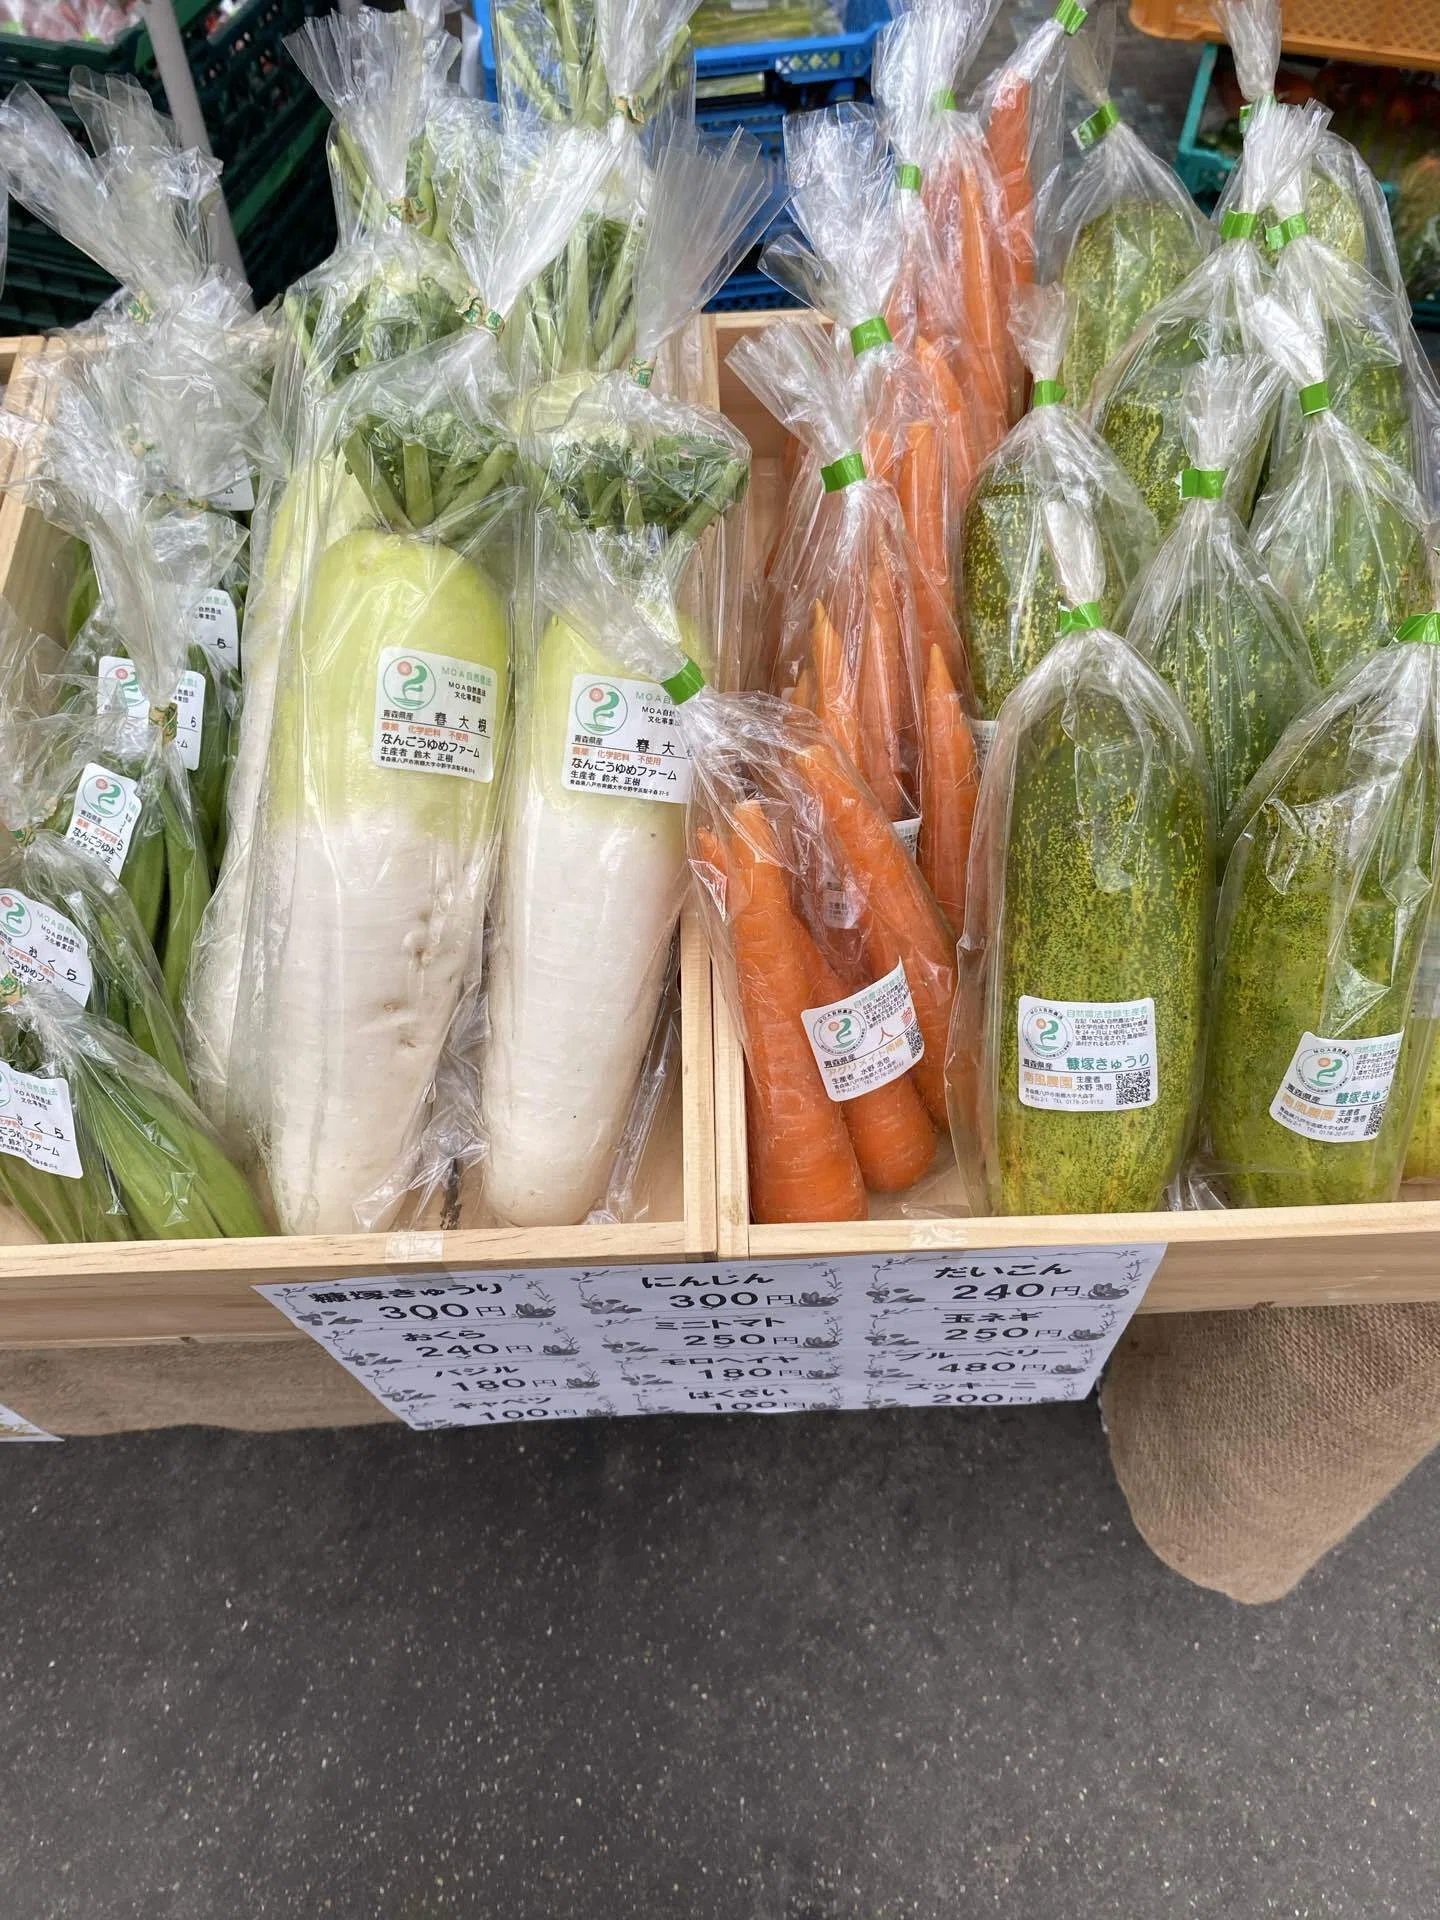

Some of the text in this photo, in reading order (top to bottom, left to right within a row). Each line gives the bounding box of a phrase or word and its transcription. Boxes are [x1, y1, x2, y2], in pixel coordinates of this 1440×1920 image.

[381, 733, 480, 759] なんごうゆめファーム
[381, 746, 408, 758] 生産者
[414, 749, 431, 760] 鈴木
[571, 758, 677, 781] なんごうゆめファーム
[570, 770, 597, 781] 生産者
[602, 773, 619, 783] 鈴木
[934, 1263, 1073, 1279] だいこん
[642, 1273, 775, 1289] にんじん
[952, 1283, 1081, 1299] 240円
[669, 1291, 796, 1308] 300円
[378, 1303, 506, 1320] 300円
[940, 1312, 1043, 1324] 玉ネギ
[655, 1317, 785, 1330] ミニトマト
[401, 1330, 486, 1342] おくら
[683, 1334, 799, 1346] 250円
[945, 1327, 1062, 1341] 250円
[416, 1343, 532, 1357] 240円
[660, 1356, 800, 1366] モロヘイヤ
[938, 1362, 1047, 1373] 480円
[699, 1368, 802, 1380] 180円
[452, 1378, 557, 1392] 180円
[905, 1381, 1037, 1391] ズッキーニ
[688, 1388, 789, 1399] はくさい
[932, 1393, 1032, 1404] 200円
[711, 1401, 805, 1411] 100円
[480, 1408, 577, 1421] 100円
